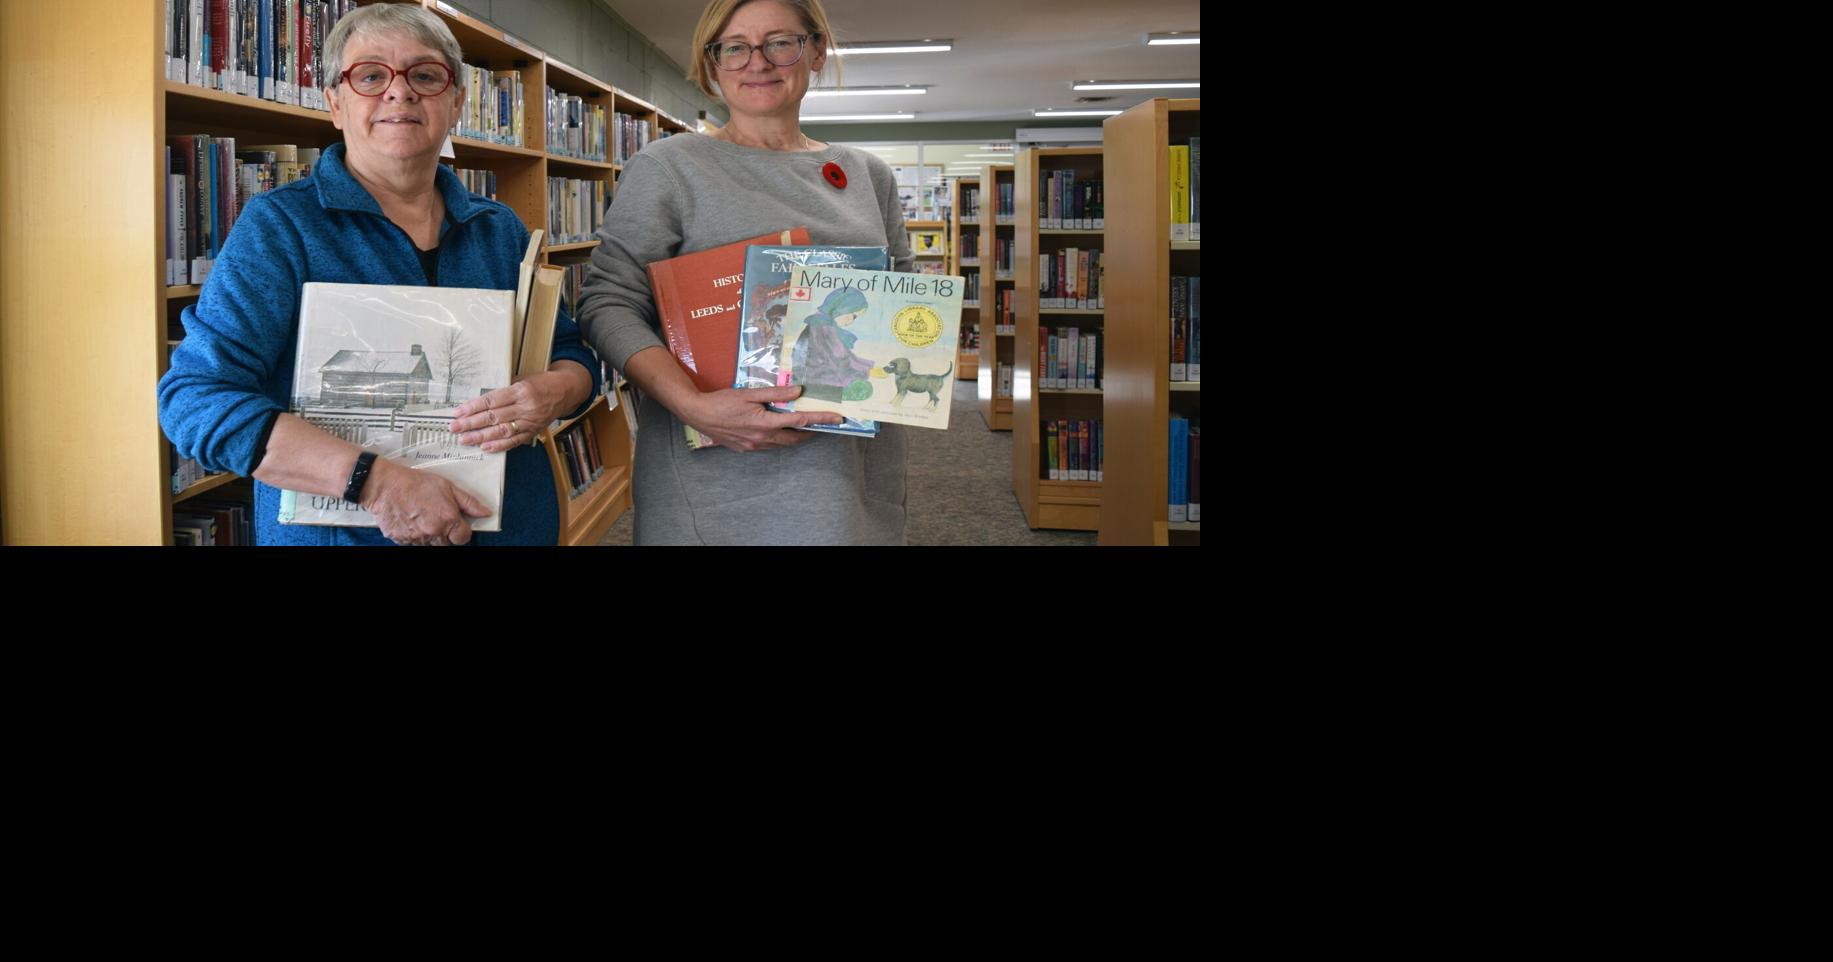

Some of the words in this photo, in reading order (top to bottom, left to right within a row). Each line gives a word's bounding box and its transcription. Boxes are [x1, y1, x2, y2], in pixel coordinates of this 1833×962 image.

[304, 15, 312, 48] Firefly
[713, 273, 744, 288] HISTO
[800, 270, 853, 293] Mary
[857, 274, 879, 292] of
[883, 275, 927, 296] Mile
[932, 279, 954, 298] 18
[690, 304, 724, 319] LEEDS
[415, 451, 440, 459] Jeanne
